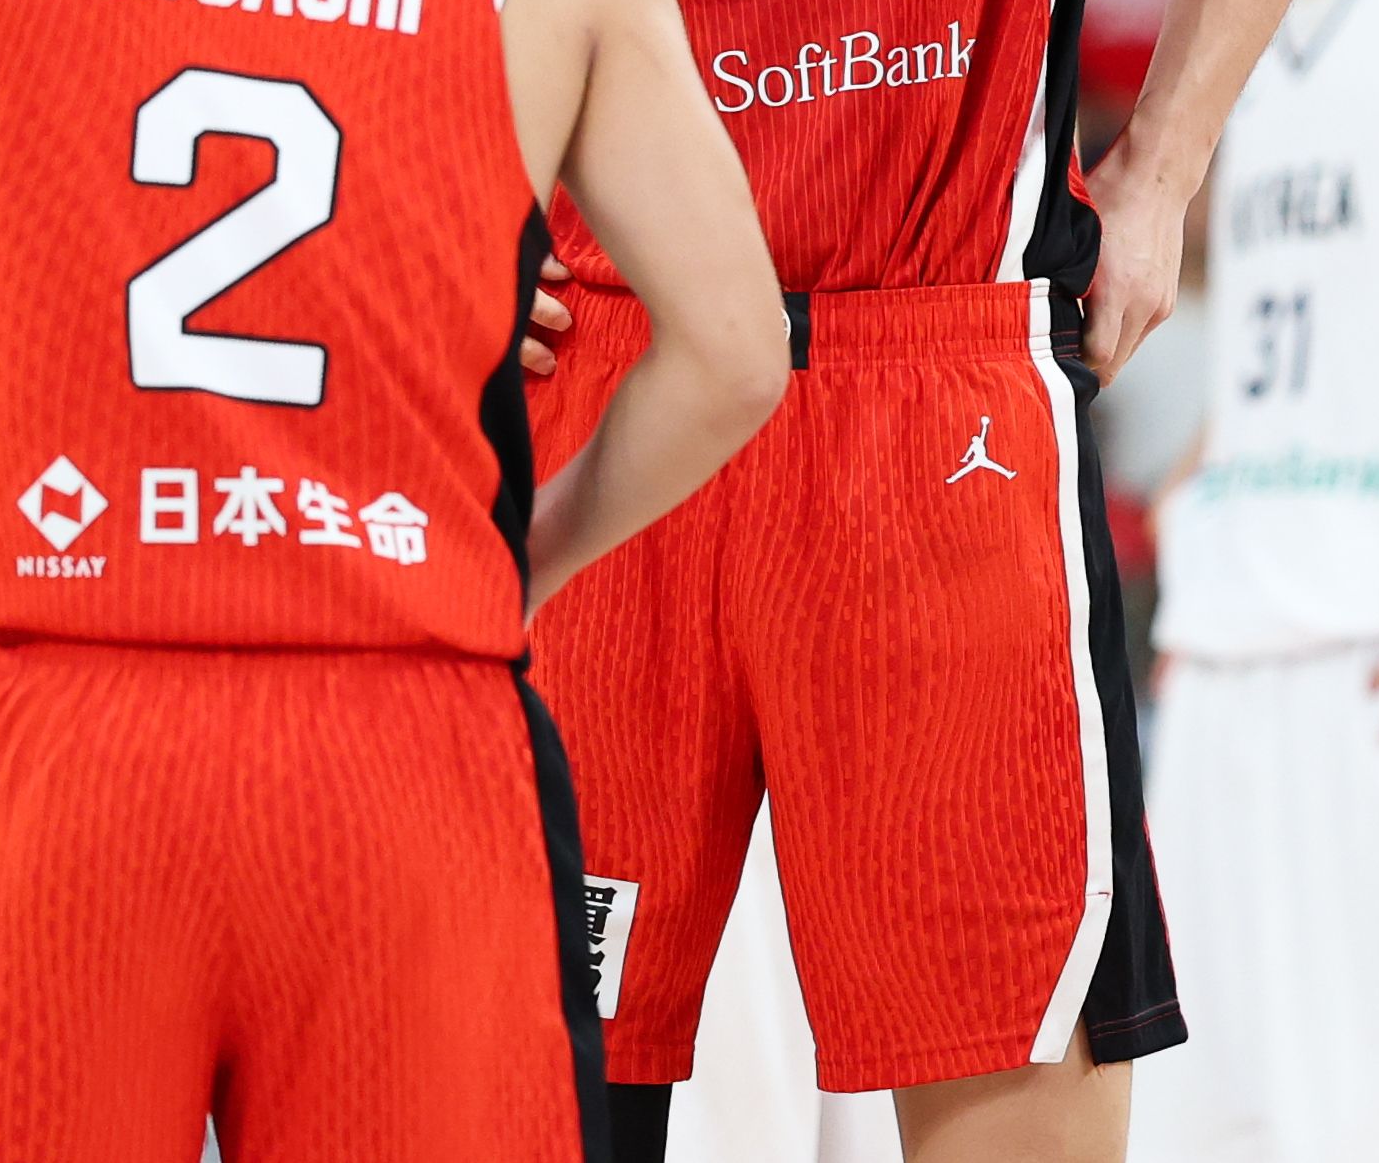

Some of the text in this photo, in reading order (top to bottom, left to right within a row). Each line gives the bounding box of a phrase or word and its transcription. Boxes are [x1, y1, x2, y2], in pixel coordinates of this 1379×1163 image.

[712, 20, 977, 113] SoftBank
[126, 66, 343, 409] 2
[140, 466, 428, 565] 日本生命
[16, 555, 107, 578] NISSAY
